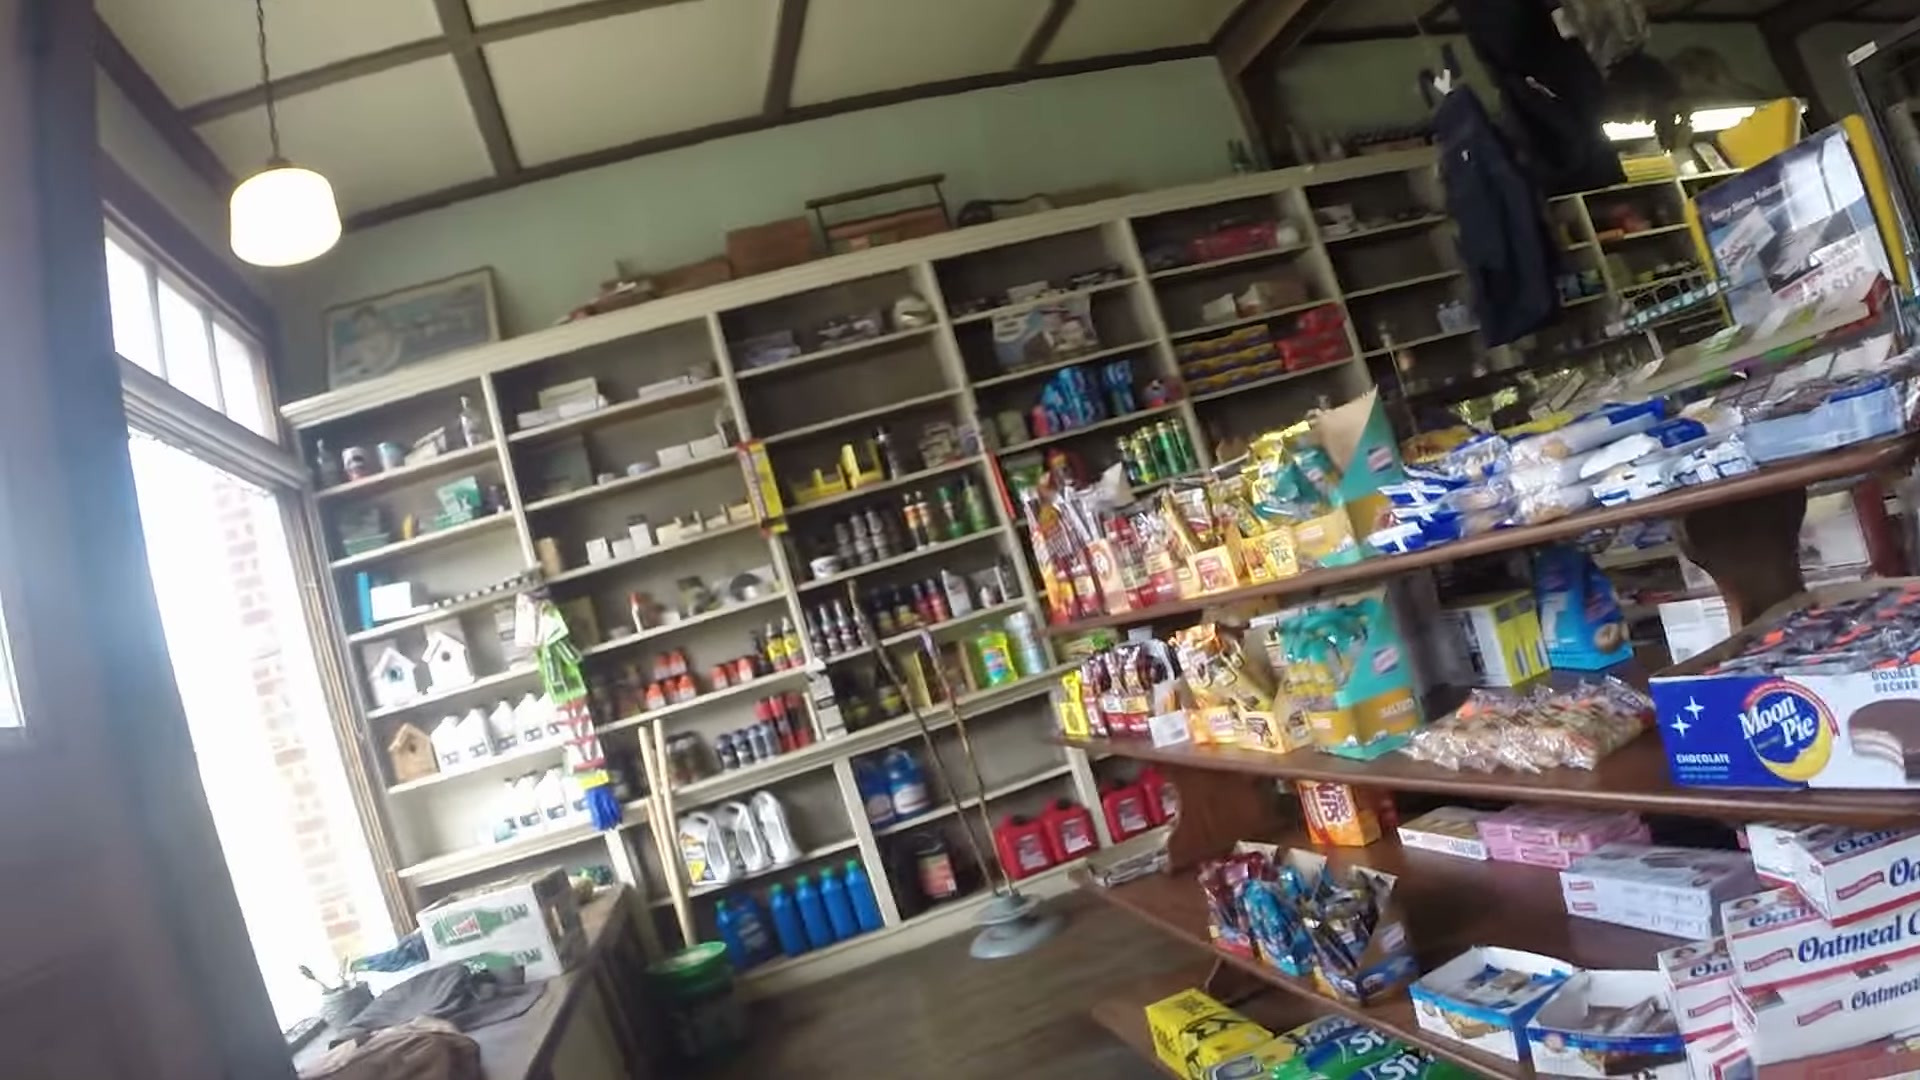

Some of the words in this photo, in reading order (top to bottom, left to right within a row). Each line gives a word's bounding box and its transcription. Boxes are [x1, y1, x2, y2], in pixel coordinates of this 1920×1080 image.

[1738, 696, 1797, 740] Moon
[1781, 714, 1815, 748] Pie
[1675, 752, 1730, 764] CHOCOLATE
[1797, 913, 1902, 964] Oatmeal
